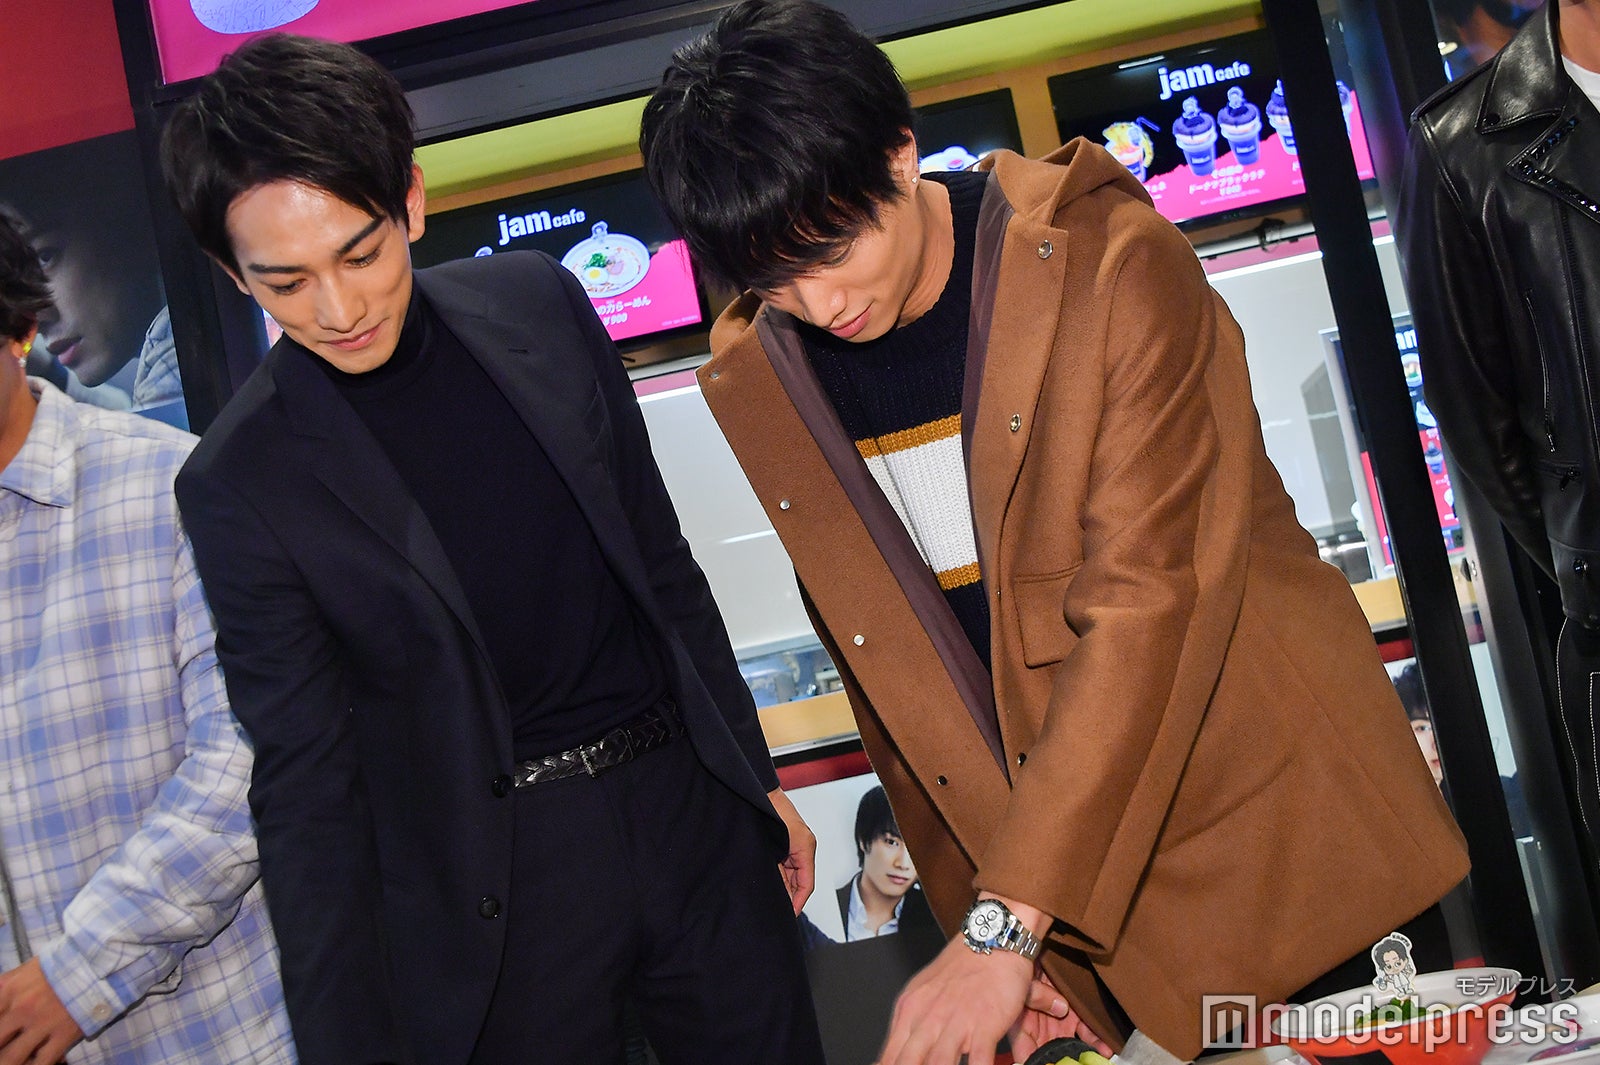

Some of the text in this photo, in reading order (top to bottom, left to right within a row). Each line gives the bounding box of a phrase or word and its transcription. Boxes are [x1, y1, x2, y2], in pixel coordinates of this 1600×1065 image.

[1158, 60, 1251, 101] jam cafe
[498, 208, 586, 246] jam cafe
